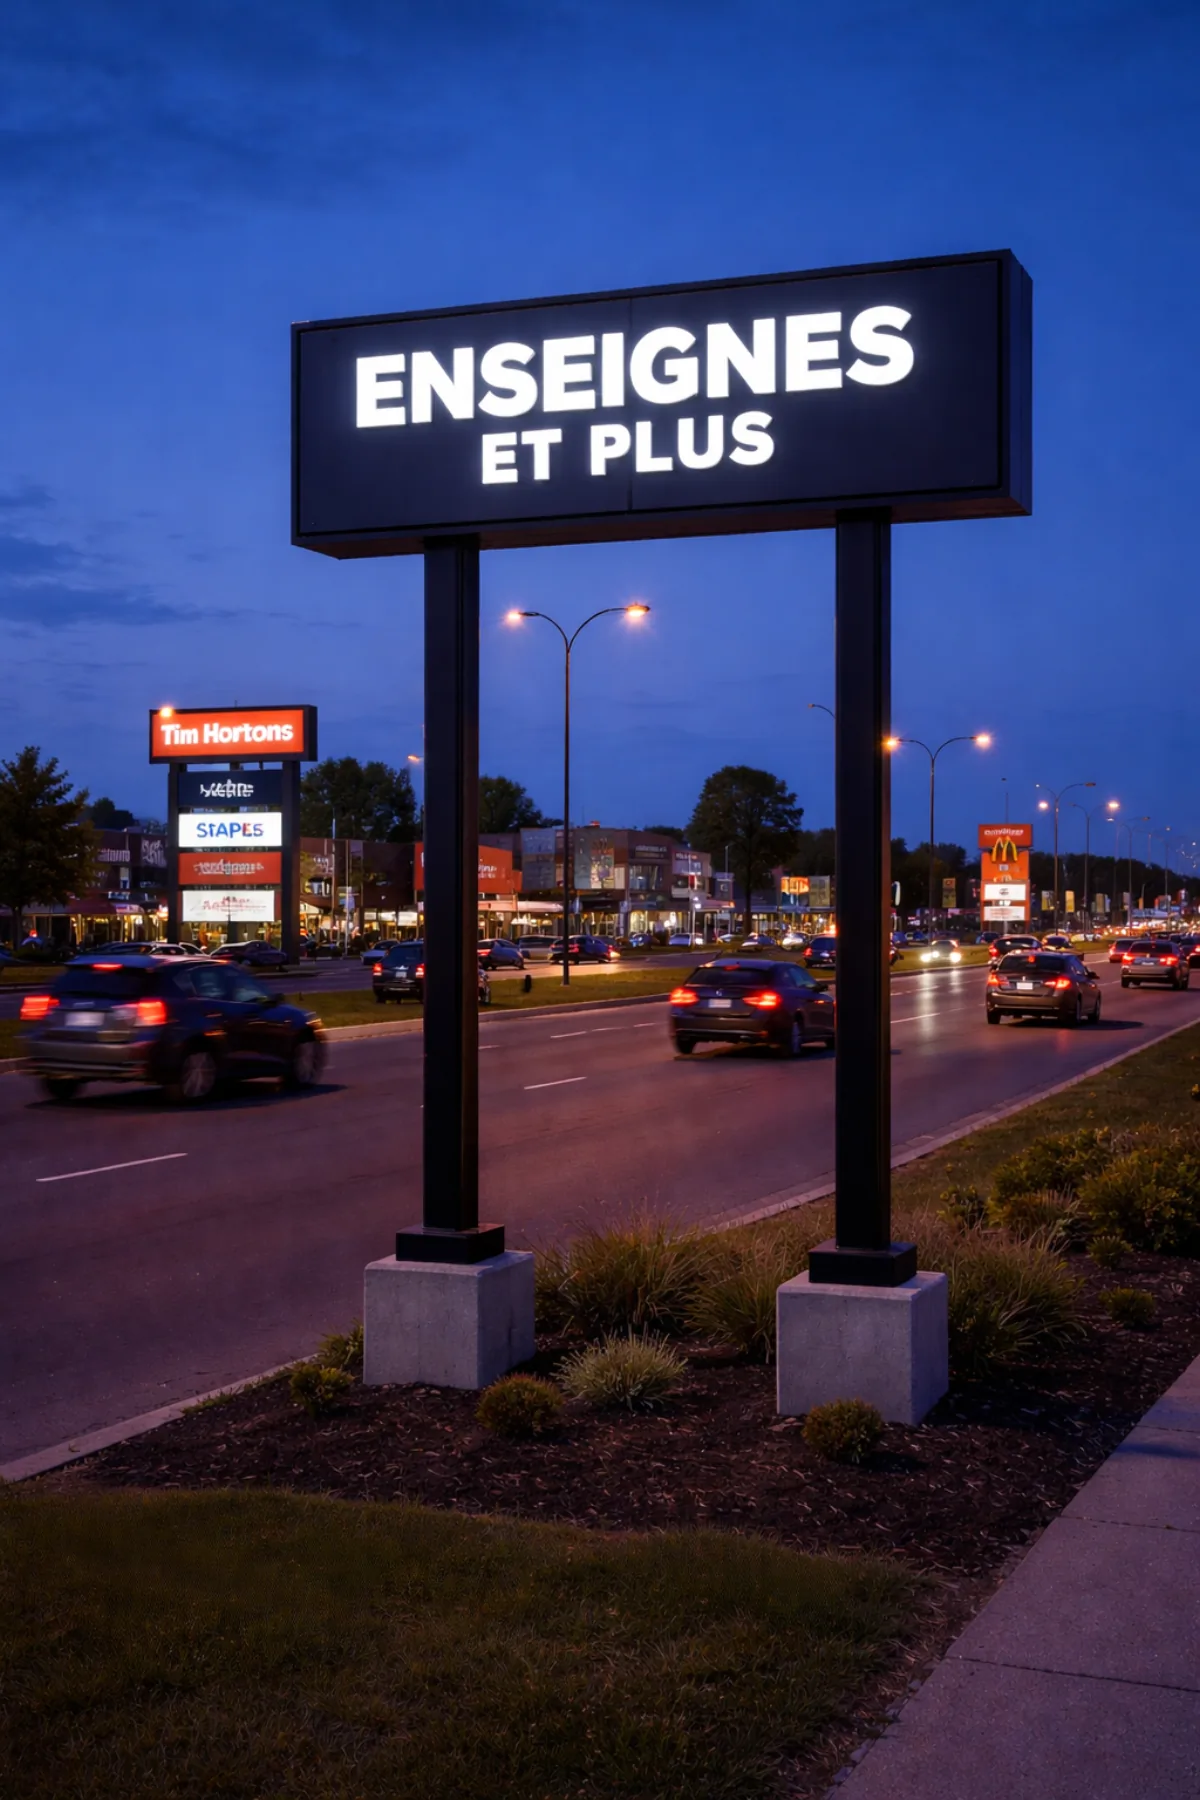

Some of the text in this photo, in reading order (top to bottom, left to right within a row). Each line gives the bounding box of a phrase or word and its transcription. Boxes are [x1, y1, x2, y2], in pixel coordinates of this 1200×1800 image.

[355, 305, 915, 429] ENSEIGNES
[481, 410, 775, 485] ET PLUS
[160, 722, 294, 746] Tim Hortons
